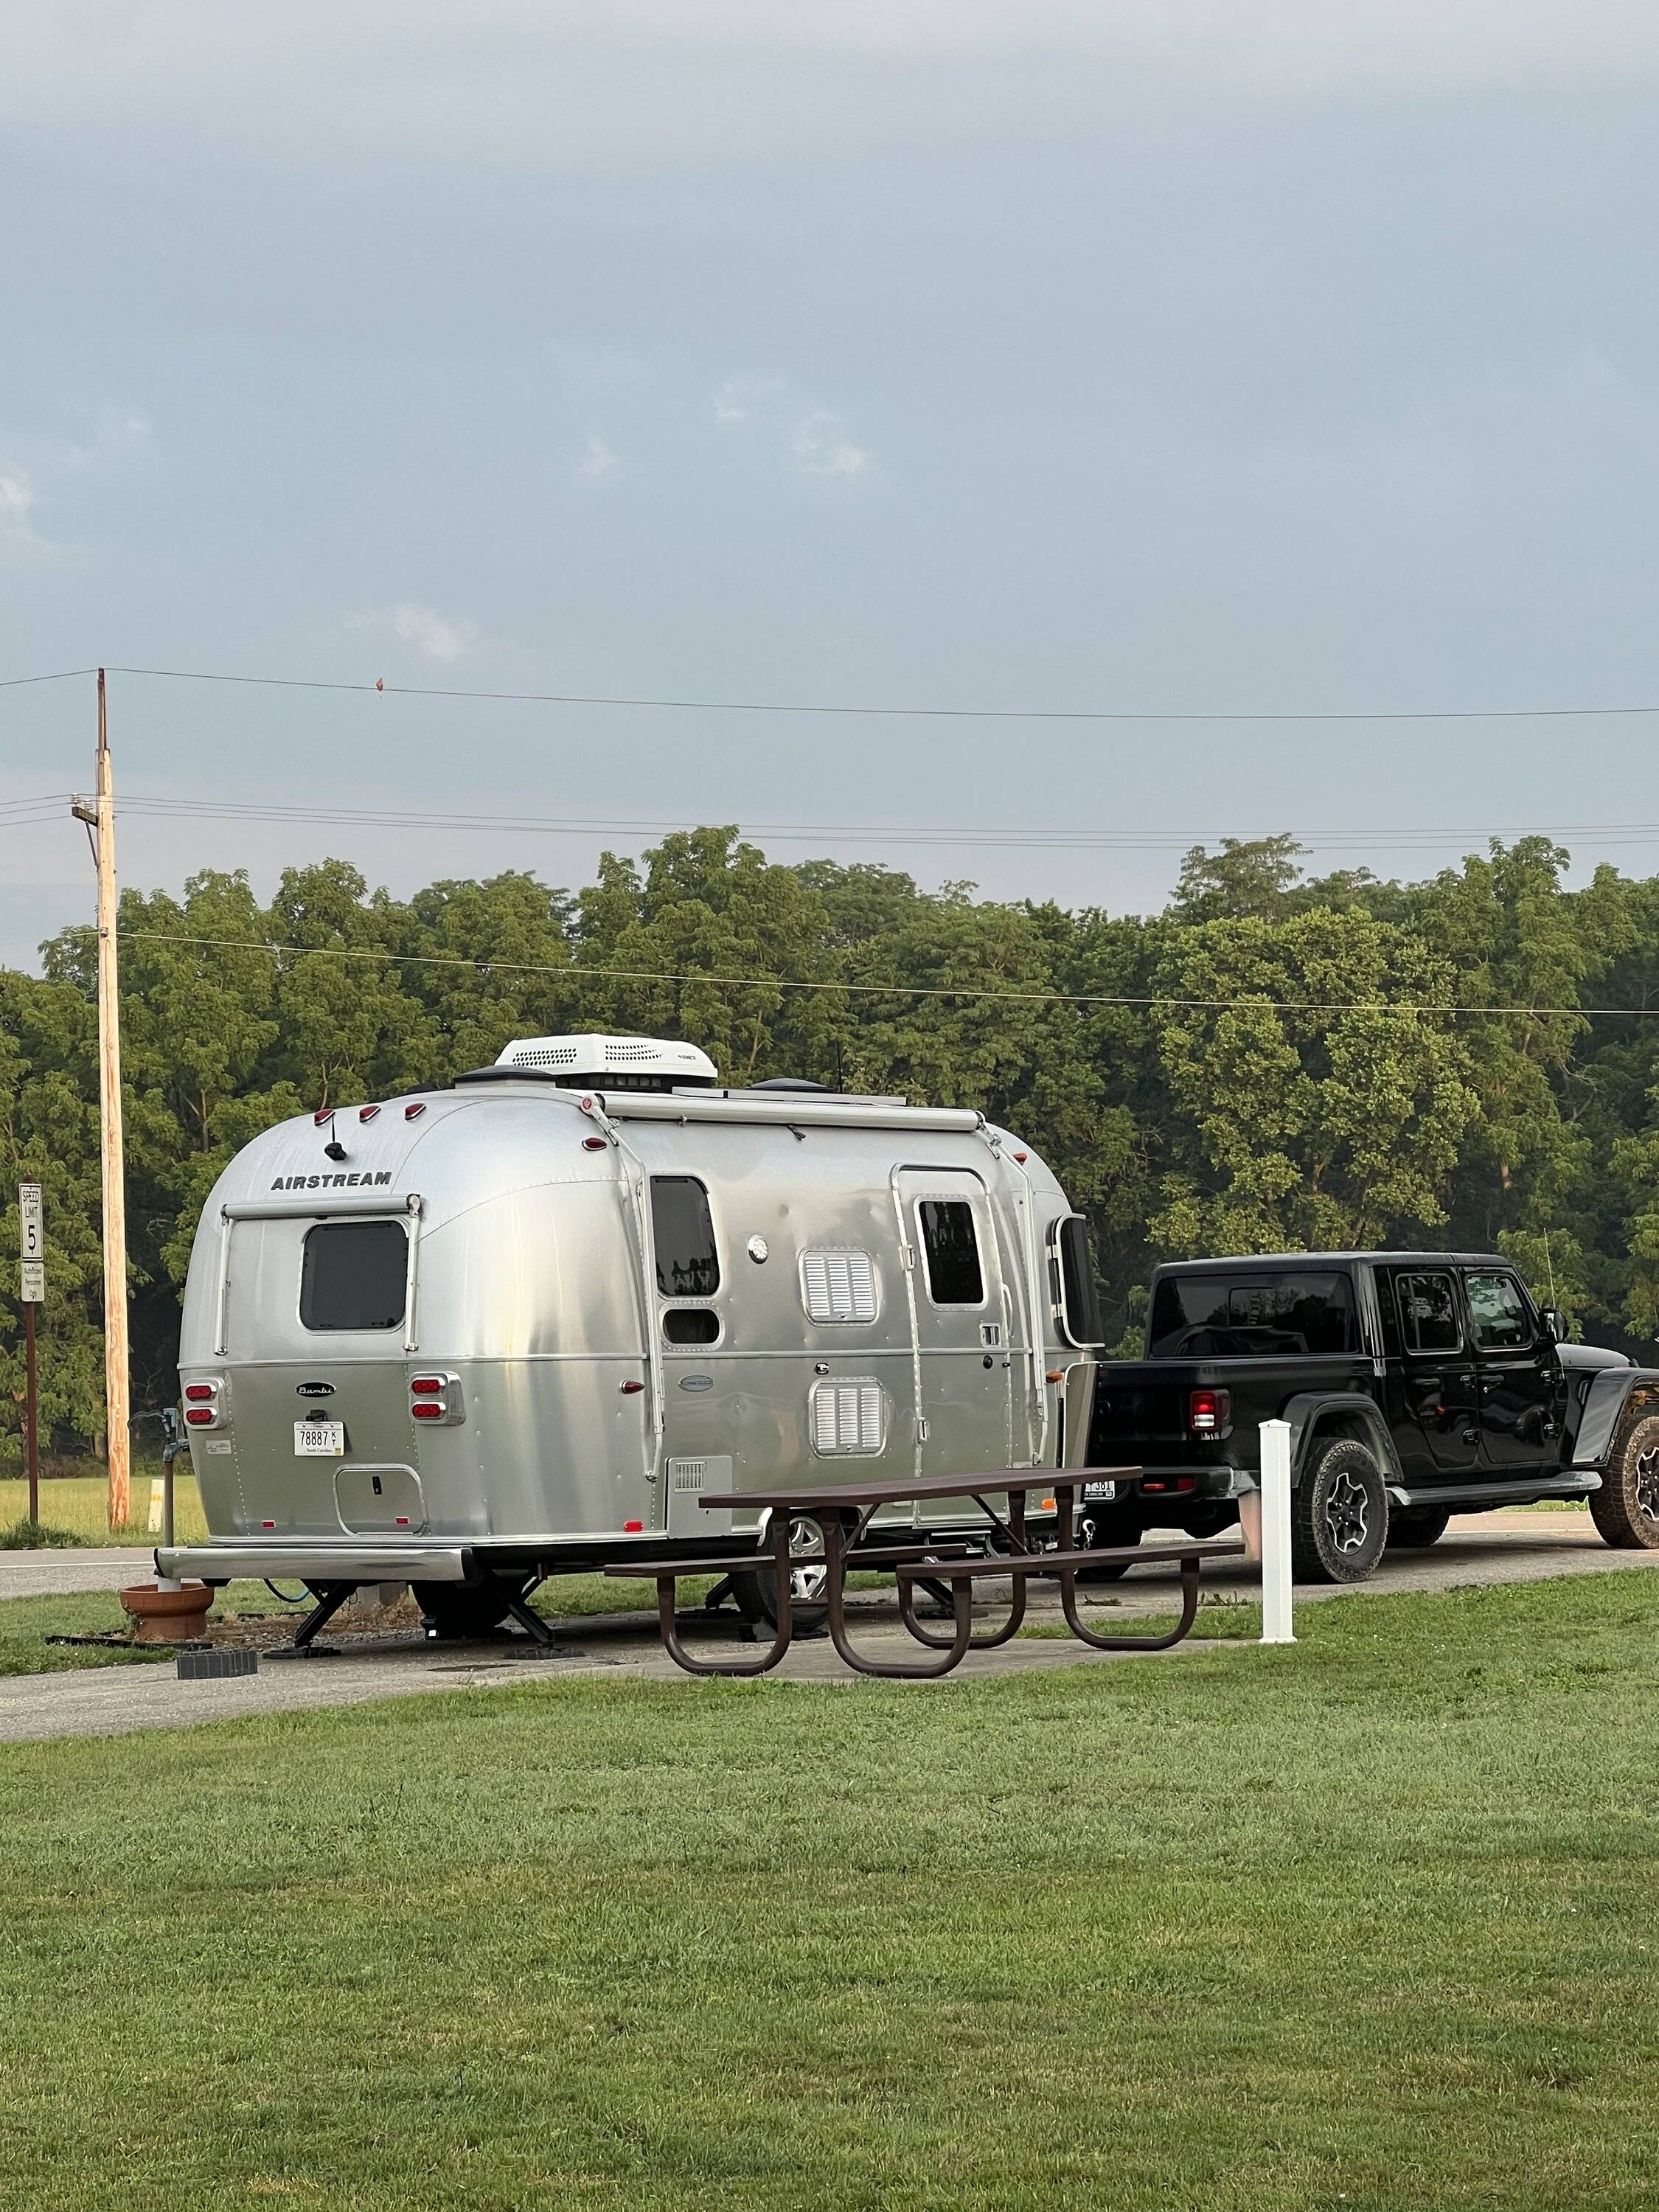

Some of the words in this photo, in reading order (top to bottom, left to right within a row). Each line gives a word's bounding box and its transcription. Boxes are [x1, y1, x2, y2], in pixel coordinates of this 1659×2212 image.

[271, 1172, 392, 1190] AIRSTREAM
[23, 1191, 38, 1202] SPEED
[25, 1206, 38, 1217] LIMIT
[28, 1225, 36, 1251] 5
[300, 1431, 328, 1445] 78887
